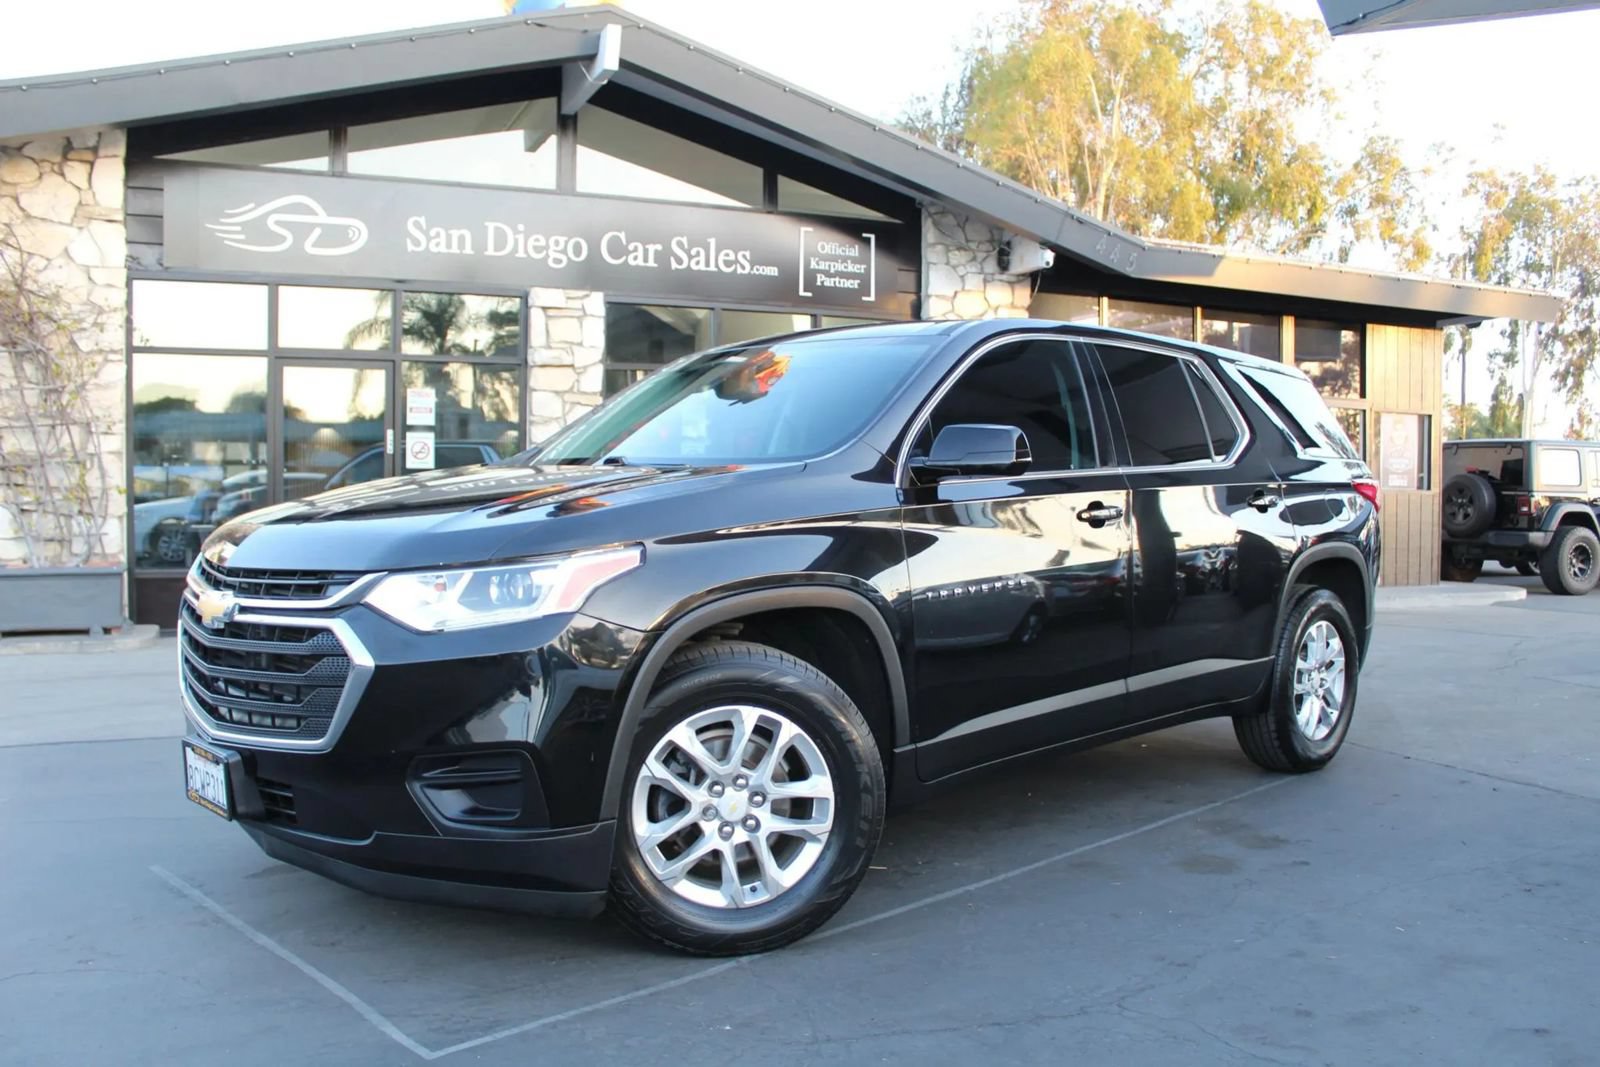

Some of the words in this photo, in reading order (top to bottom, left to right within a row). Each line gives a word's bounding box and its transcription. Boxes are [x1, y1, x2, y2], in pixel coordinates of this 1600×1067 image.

[406, 215, 475, 255] San
[484, 221, 589, 269] Diego
[600, 231, 663, 268] Car
[817, 241, 860, 258] Official
[809, 256, 867, 275] Karpicker
[816, 273, 861, 290] Partner
